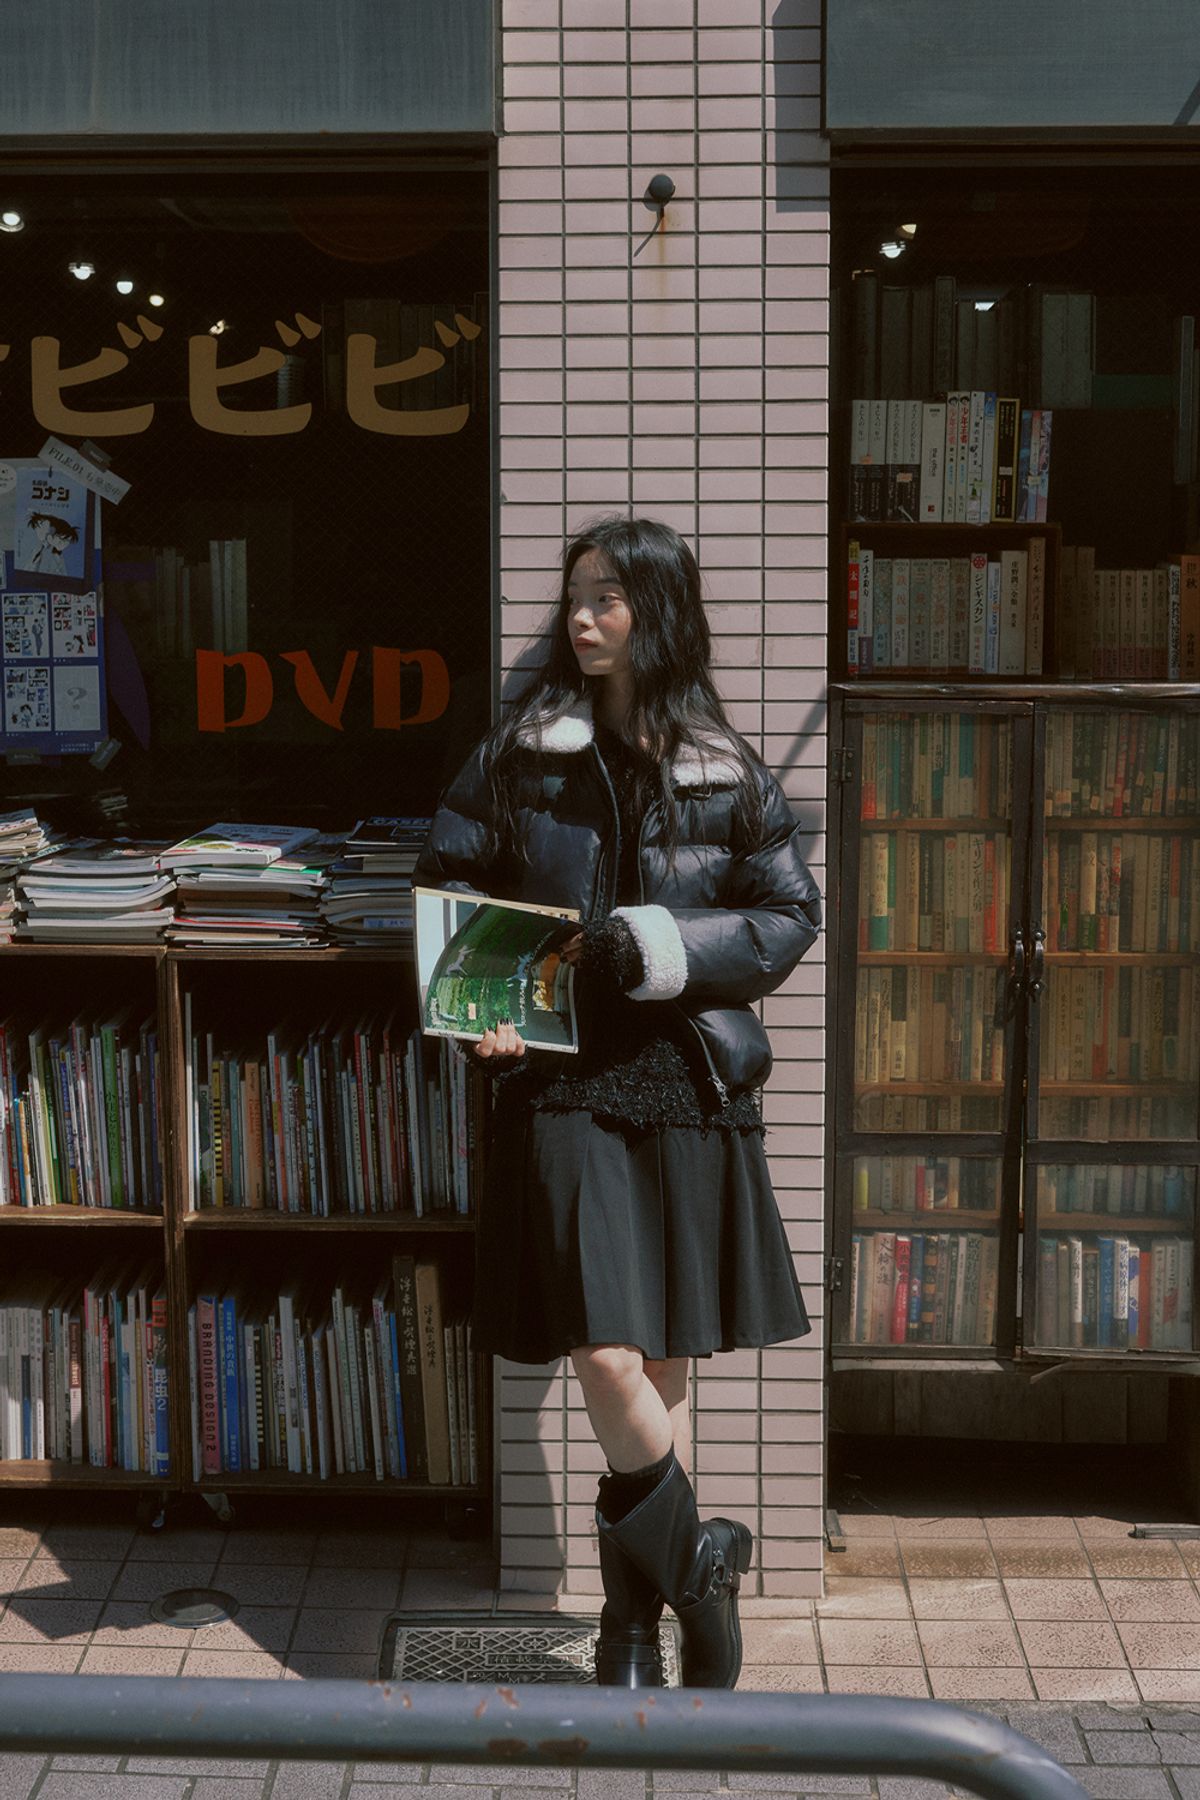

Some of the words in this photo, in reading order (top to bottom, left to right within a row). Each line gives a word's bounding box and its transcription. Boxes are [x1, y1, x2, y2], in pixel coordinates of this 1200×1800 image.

[0, 312, 482, 437] ビビビ
[32, 486, 70, 501] コナン
[973, 573, 985, 624] ジンギスカン
[195, 646, 451, 733] DVD
[156, 1398, 168, 1411] 2
[458, 1638, 479, 1650] 水
